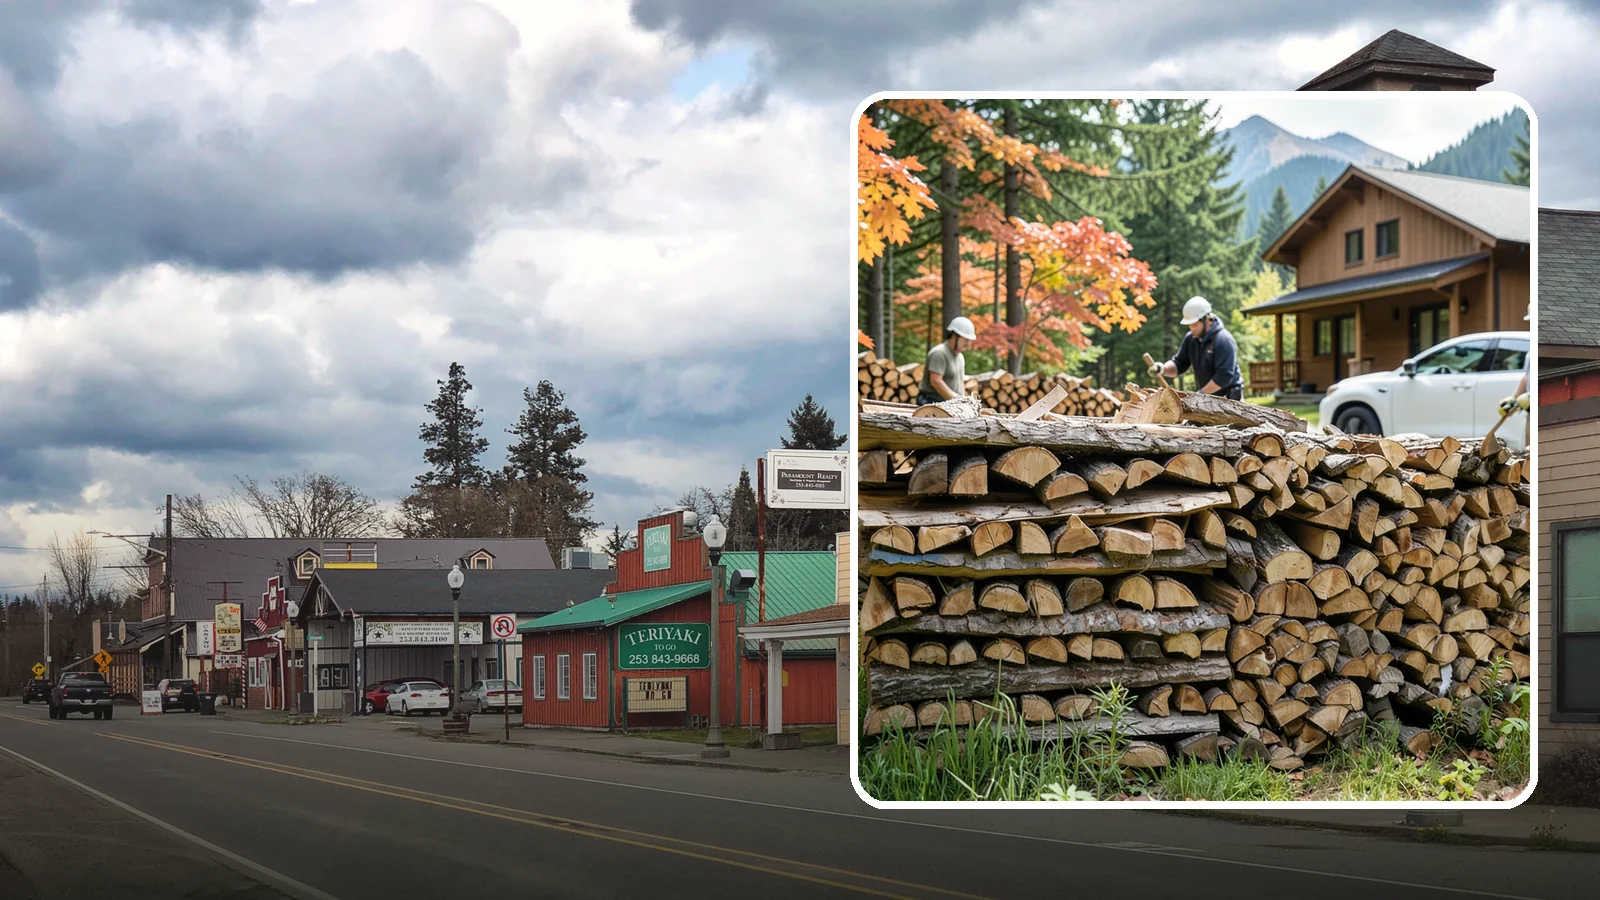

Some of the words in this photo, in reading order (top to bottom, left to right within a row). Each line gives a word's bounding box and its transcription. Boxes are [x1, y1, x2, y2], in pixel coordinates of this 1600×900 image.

[625, 628, 702, 646] TERIYAKI
[629, 654, 648, 664] 253
[652, 654, 700, 664] 843-9668
[639, 681, 672, 691] TERIYAKI
